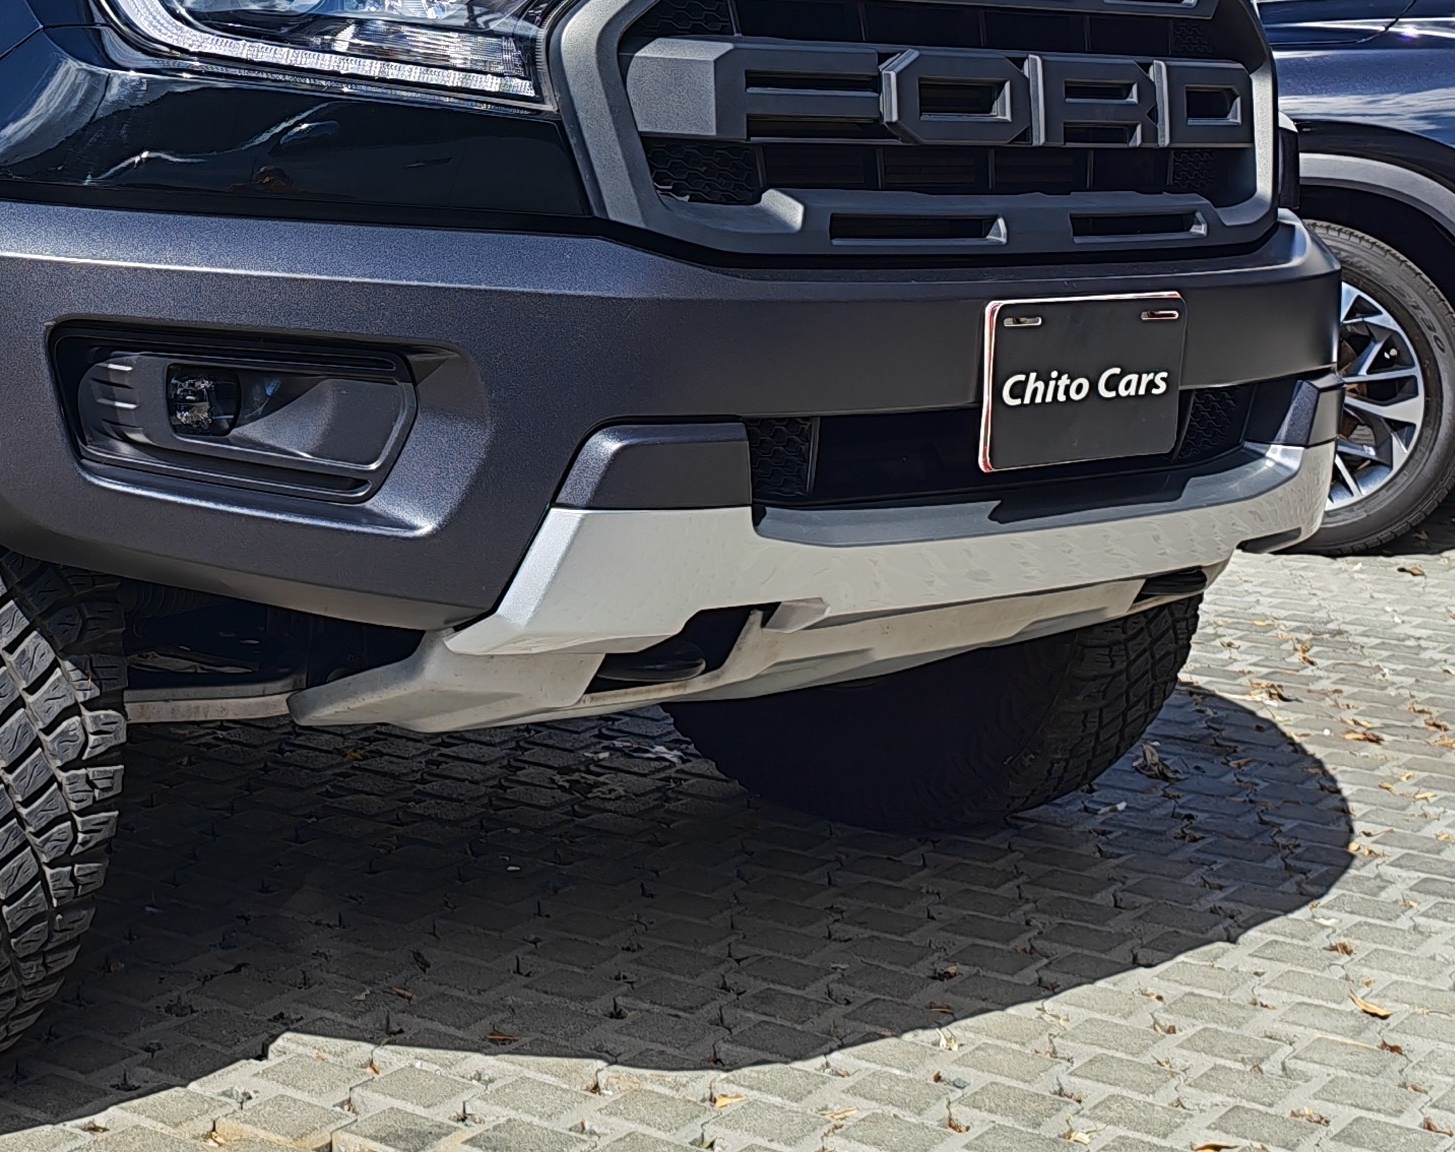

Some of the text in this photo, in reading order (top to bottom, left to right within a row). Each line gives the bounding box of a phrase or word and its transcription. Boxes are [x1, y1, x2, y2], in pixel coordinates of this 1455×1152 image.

[626, 37, 1253, 147] FORD
[1001, 367, 1169, 407] Chito Cars
